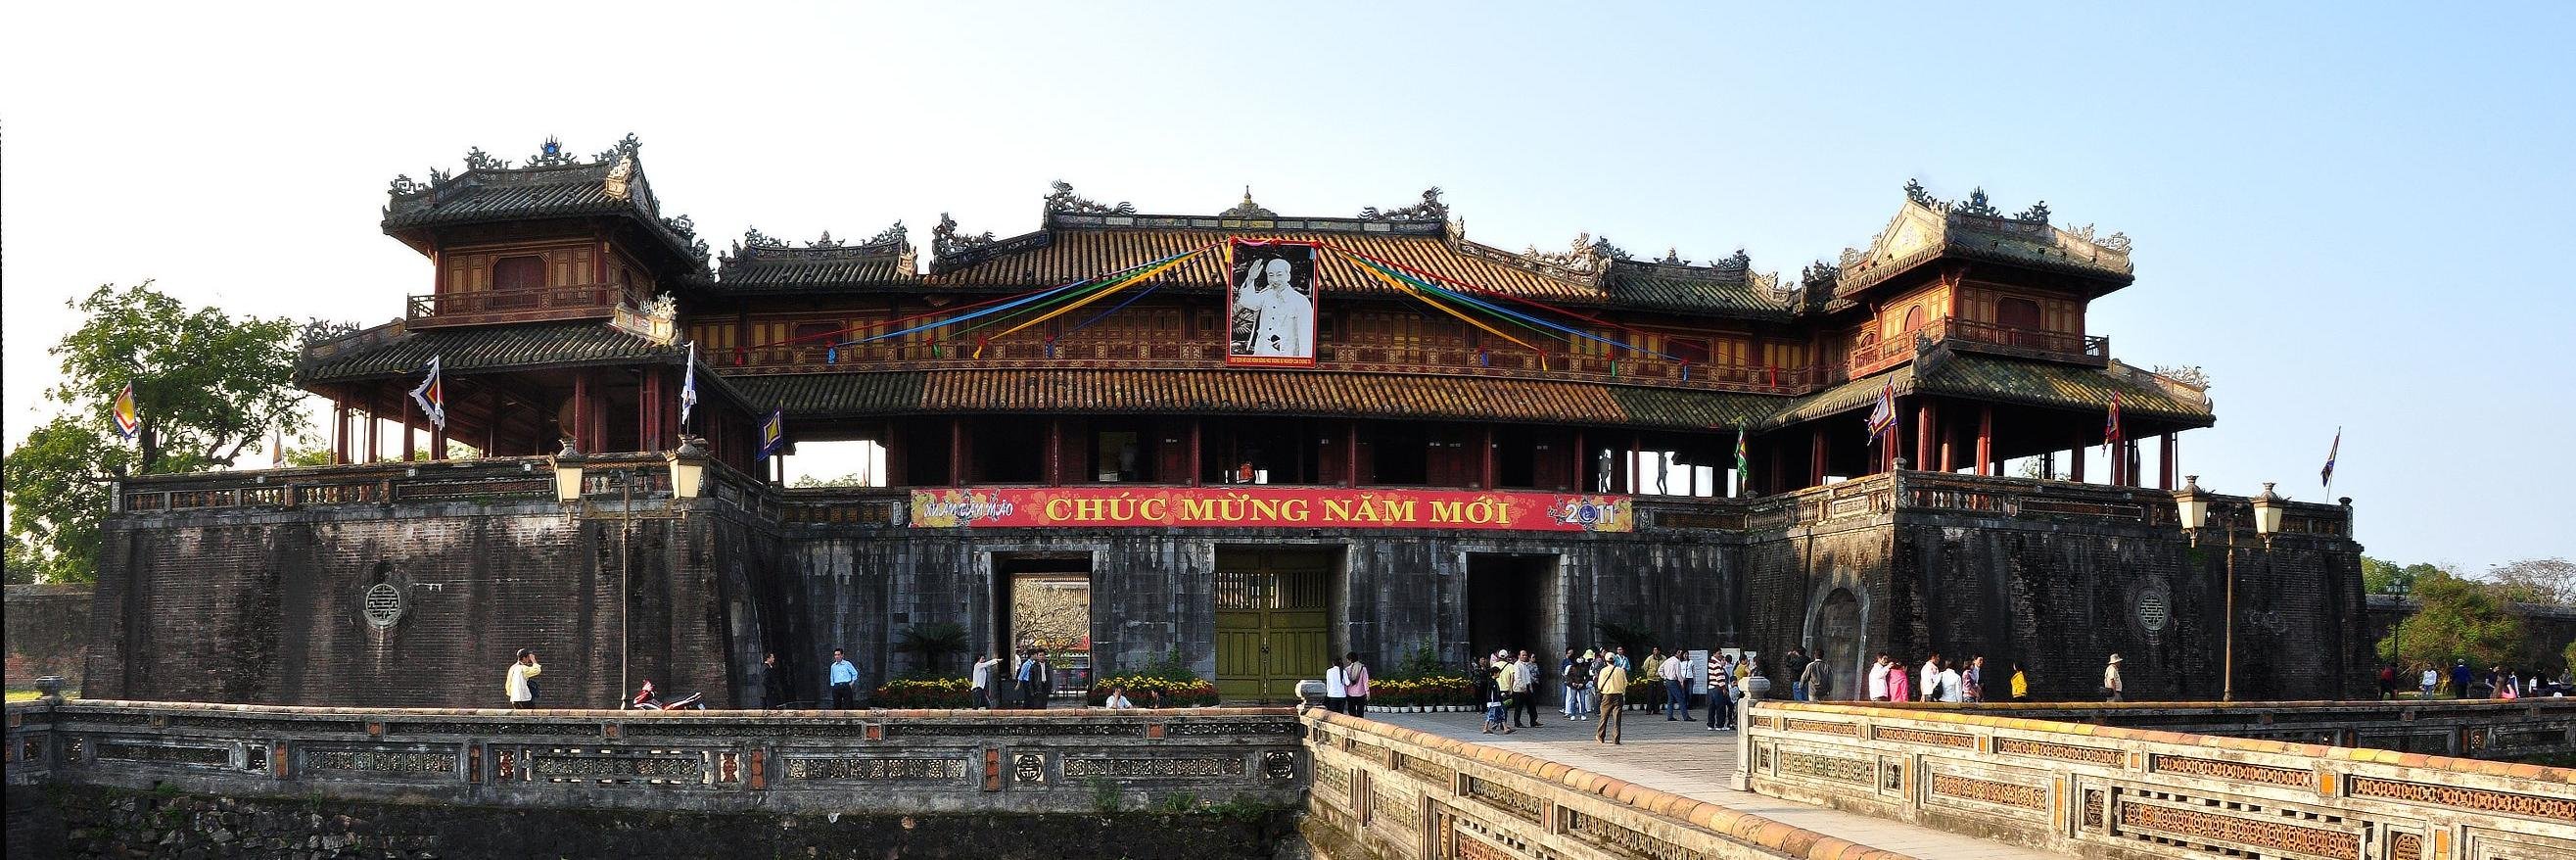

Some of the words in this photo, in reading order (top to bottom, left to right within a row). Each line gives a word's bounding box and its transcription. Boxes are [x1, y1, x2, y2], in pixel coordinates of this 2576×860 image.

[1045, 492, 1167, 521] CHÚC
[1180, 492, 1311, 521] MỪNG
[1322, 494, 1417, 522] NĂM
[1429, 496, 1511, 524] MỚI
[1566, 503, 1615, 524] 2011
